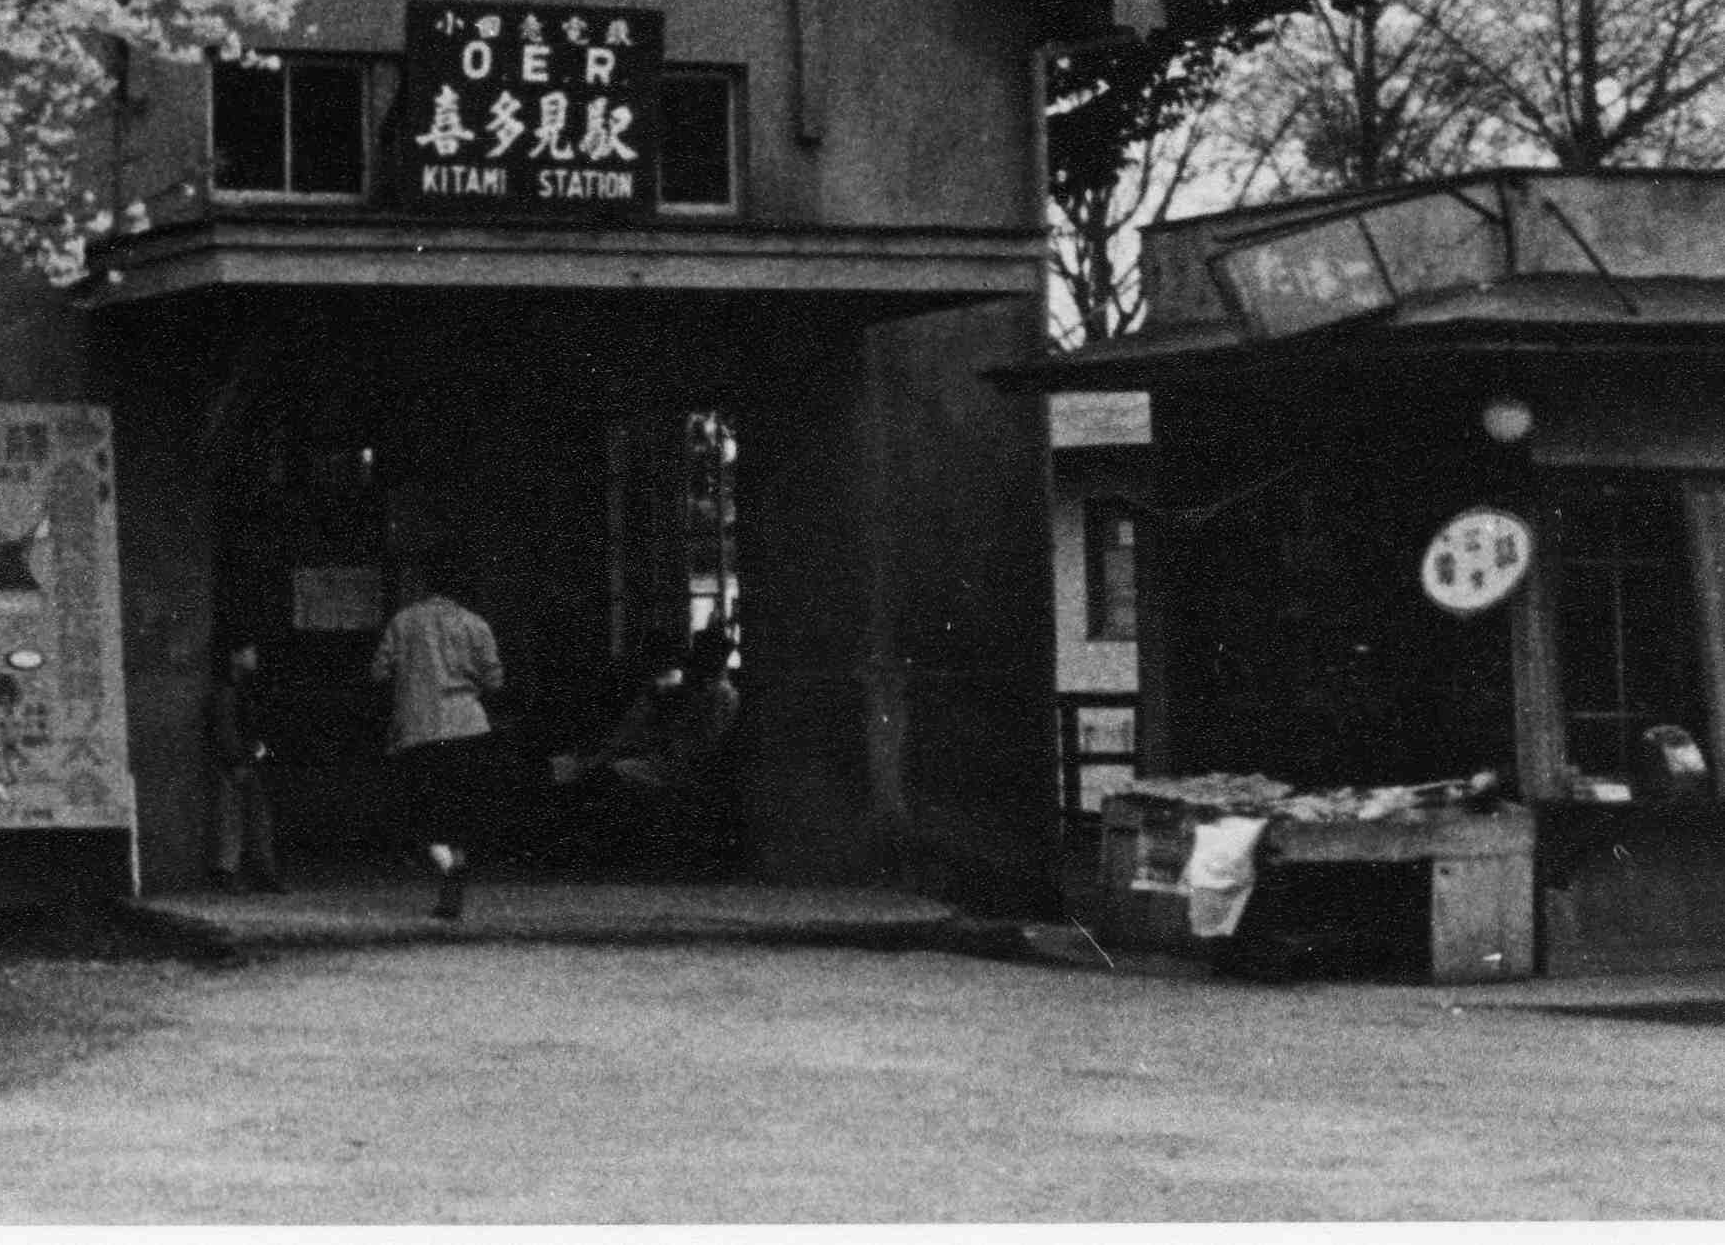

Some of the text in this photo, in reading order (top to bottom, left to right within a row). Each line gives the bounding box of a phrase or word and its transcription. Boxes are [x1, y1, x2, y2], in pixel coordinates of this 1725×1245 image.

[462, 40, 616, 84] OER
[423, 164, 633, 199] KITAMI STATION
